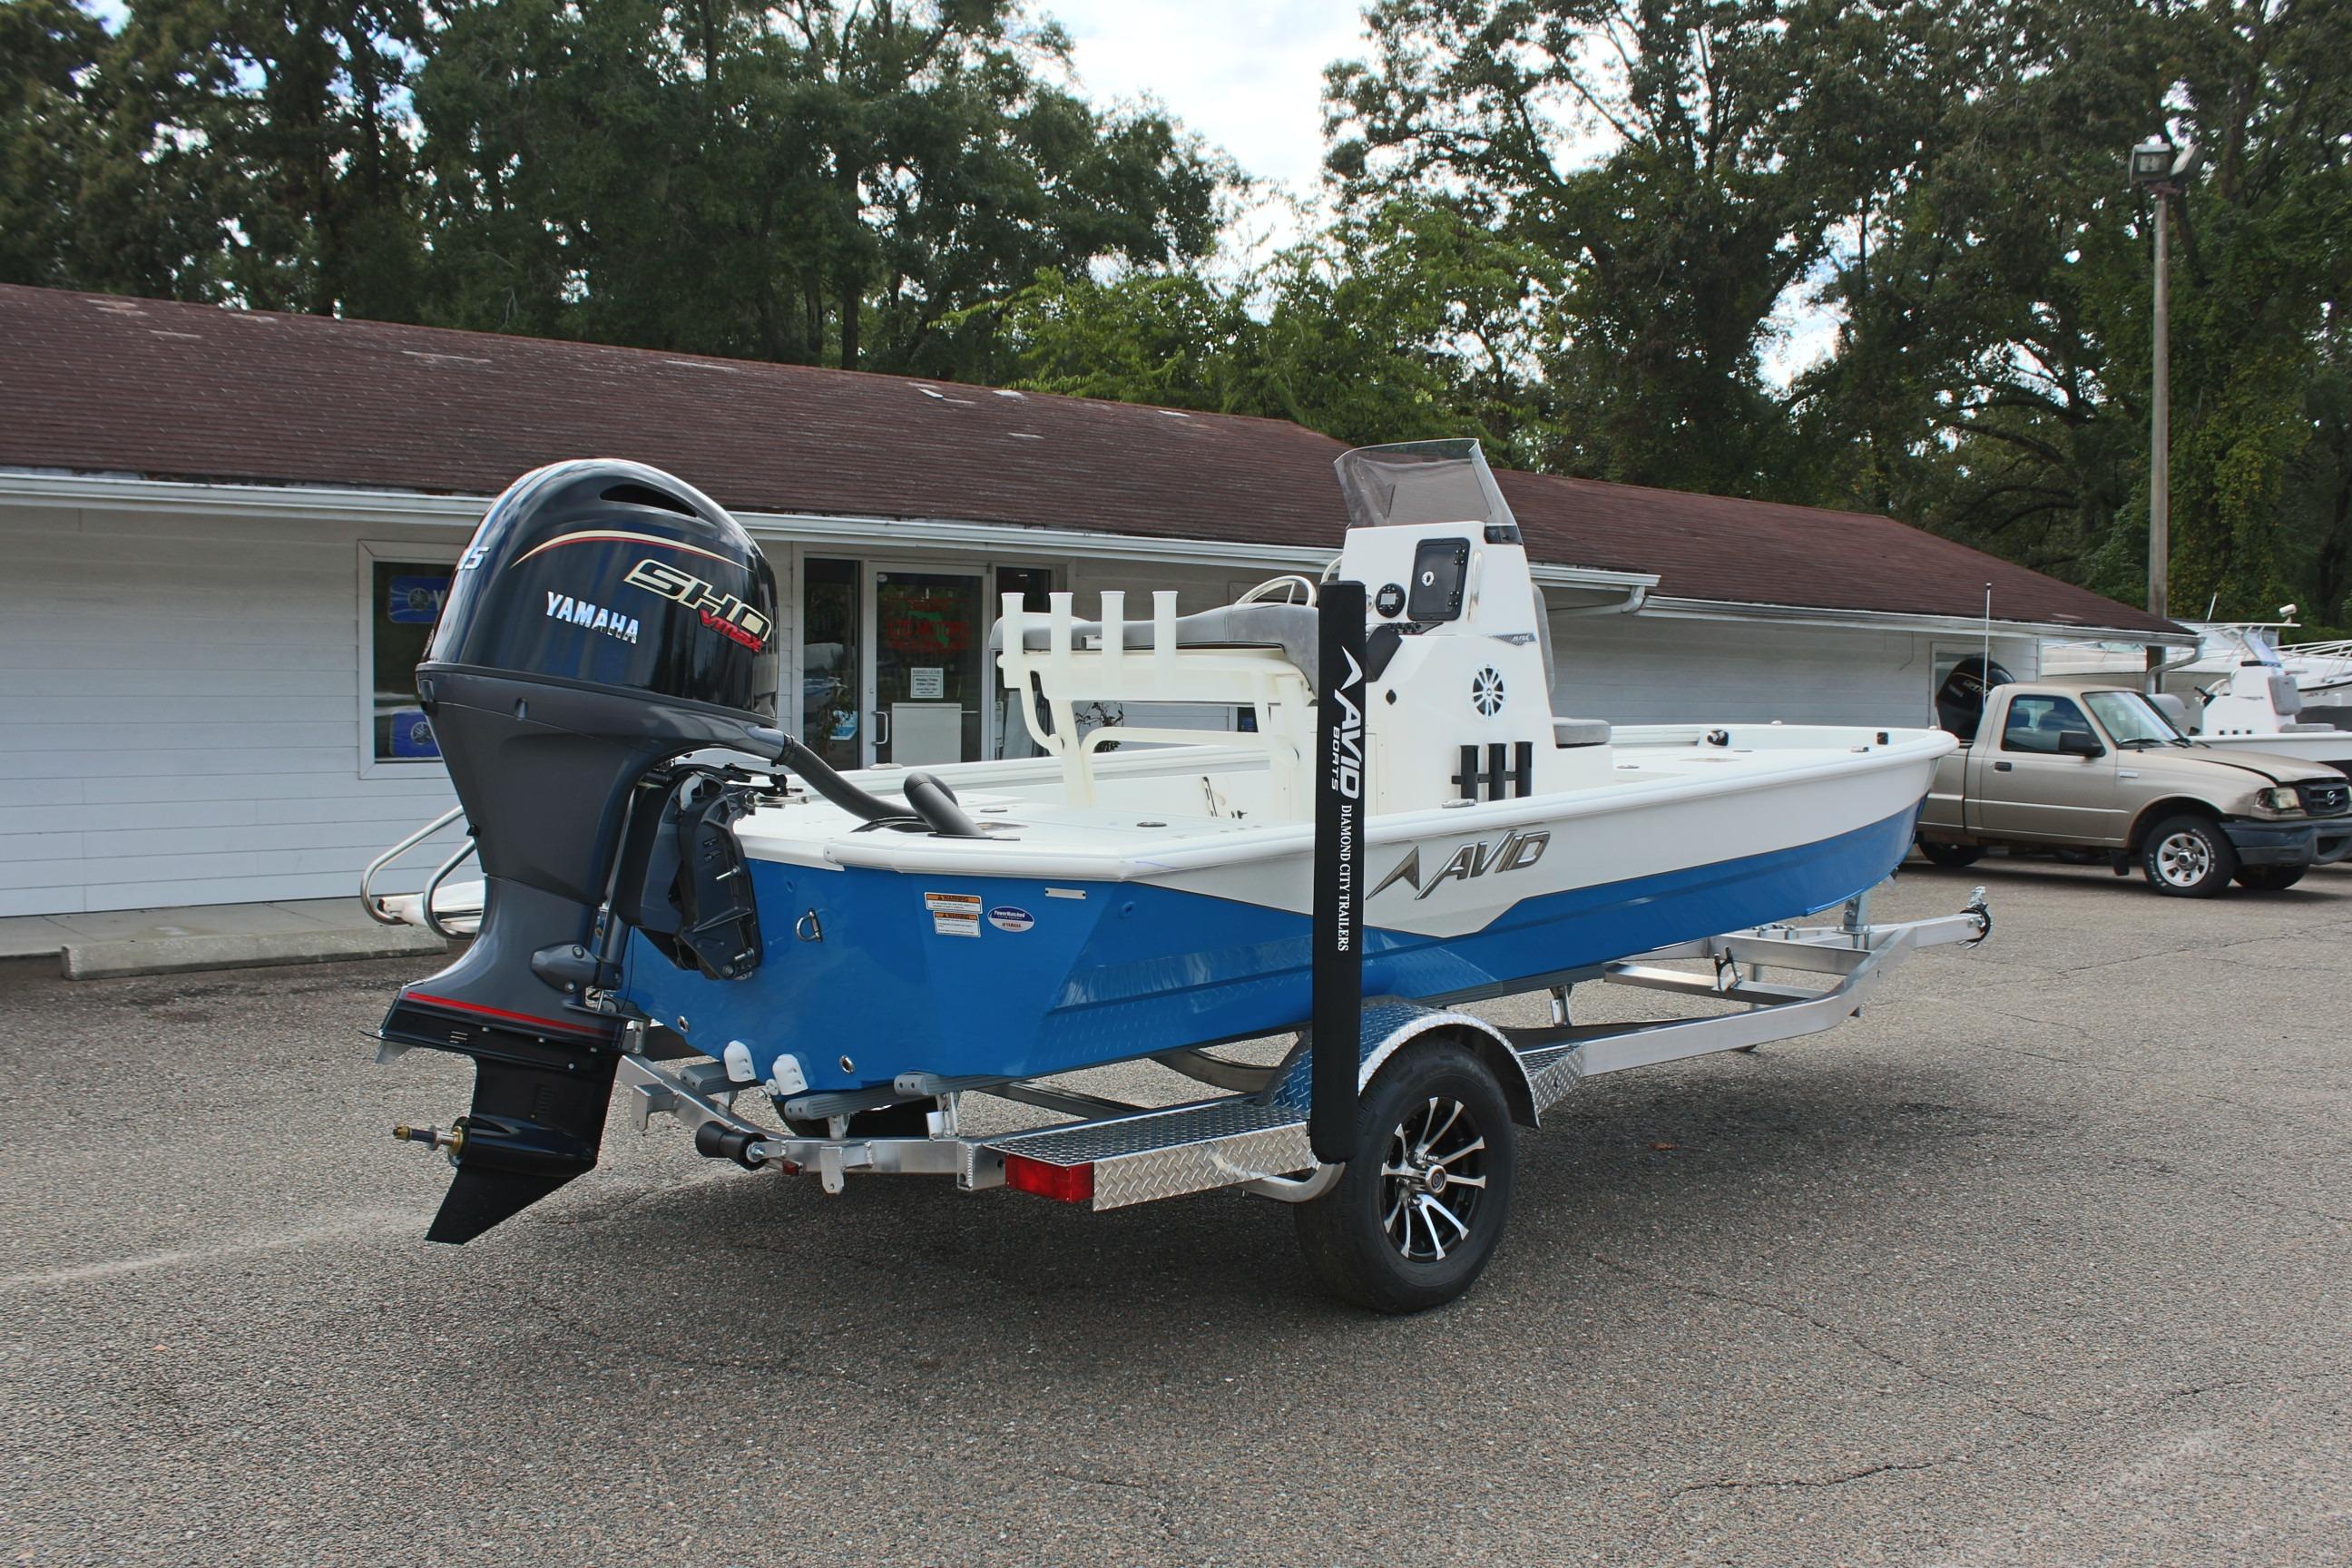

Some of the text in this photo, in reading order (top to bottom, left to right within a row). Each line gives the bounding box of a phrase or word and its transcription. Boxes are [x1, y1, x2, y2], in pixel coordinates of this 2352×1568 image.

[546, 591, 640, 644] YAMAHA
[623, 558, 771, 642] SHO
[1331, 725, 1339, 791] BOATS
[1334, 689, 1361, 800] AVID
[1338, 804, 1352, 952] DIAMOND CITY TRAILERS
[1415, 829, 1551, 900] AVID
